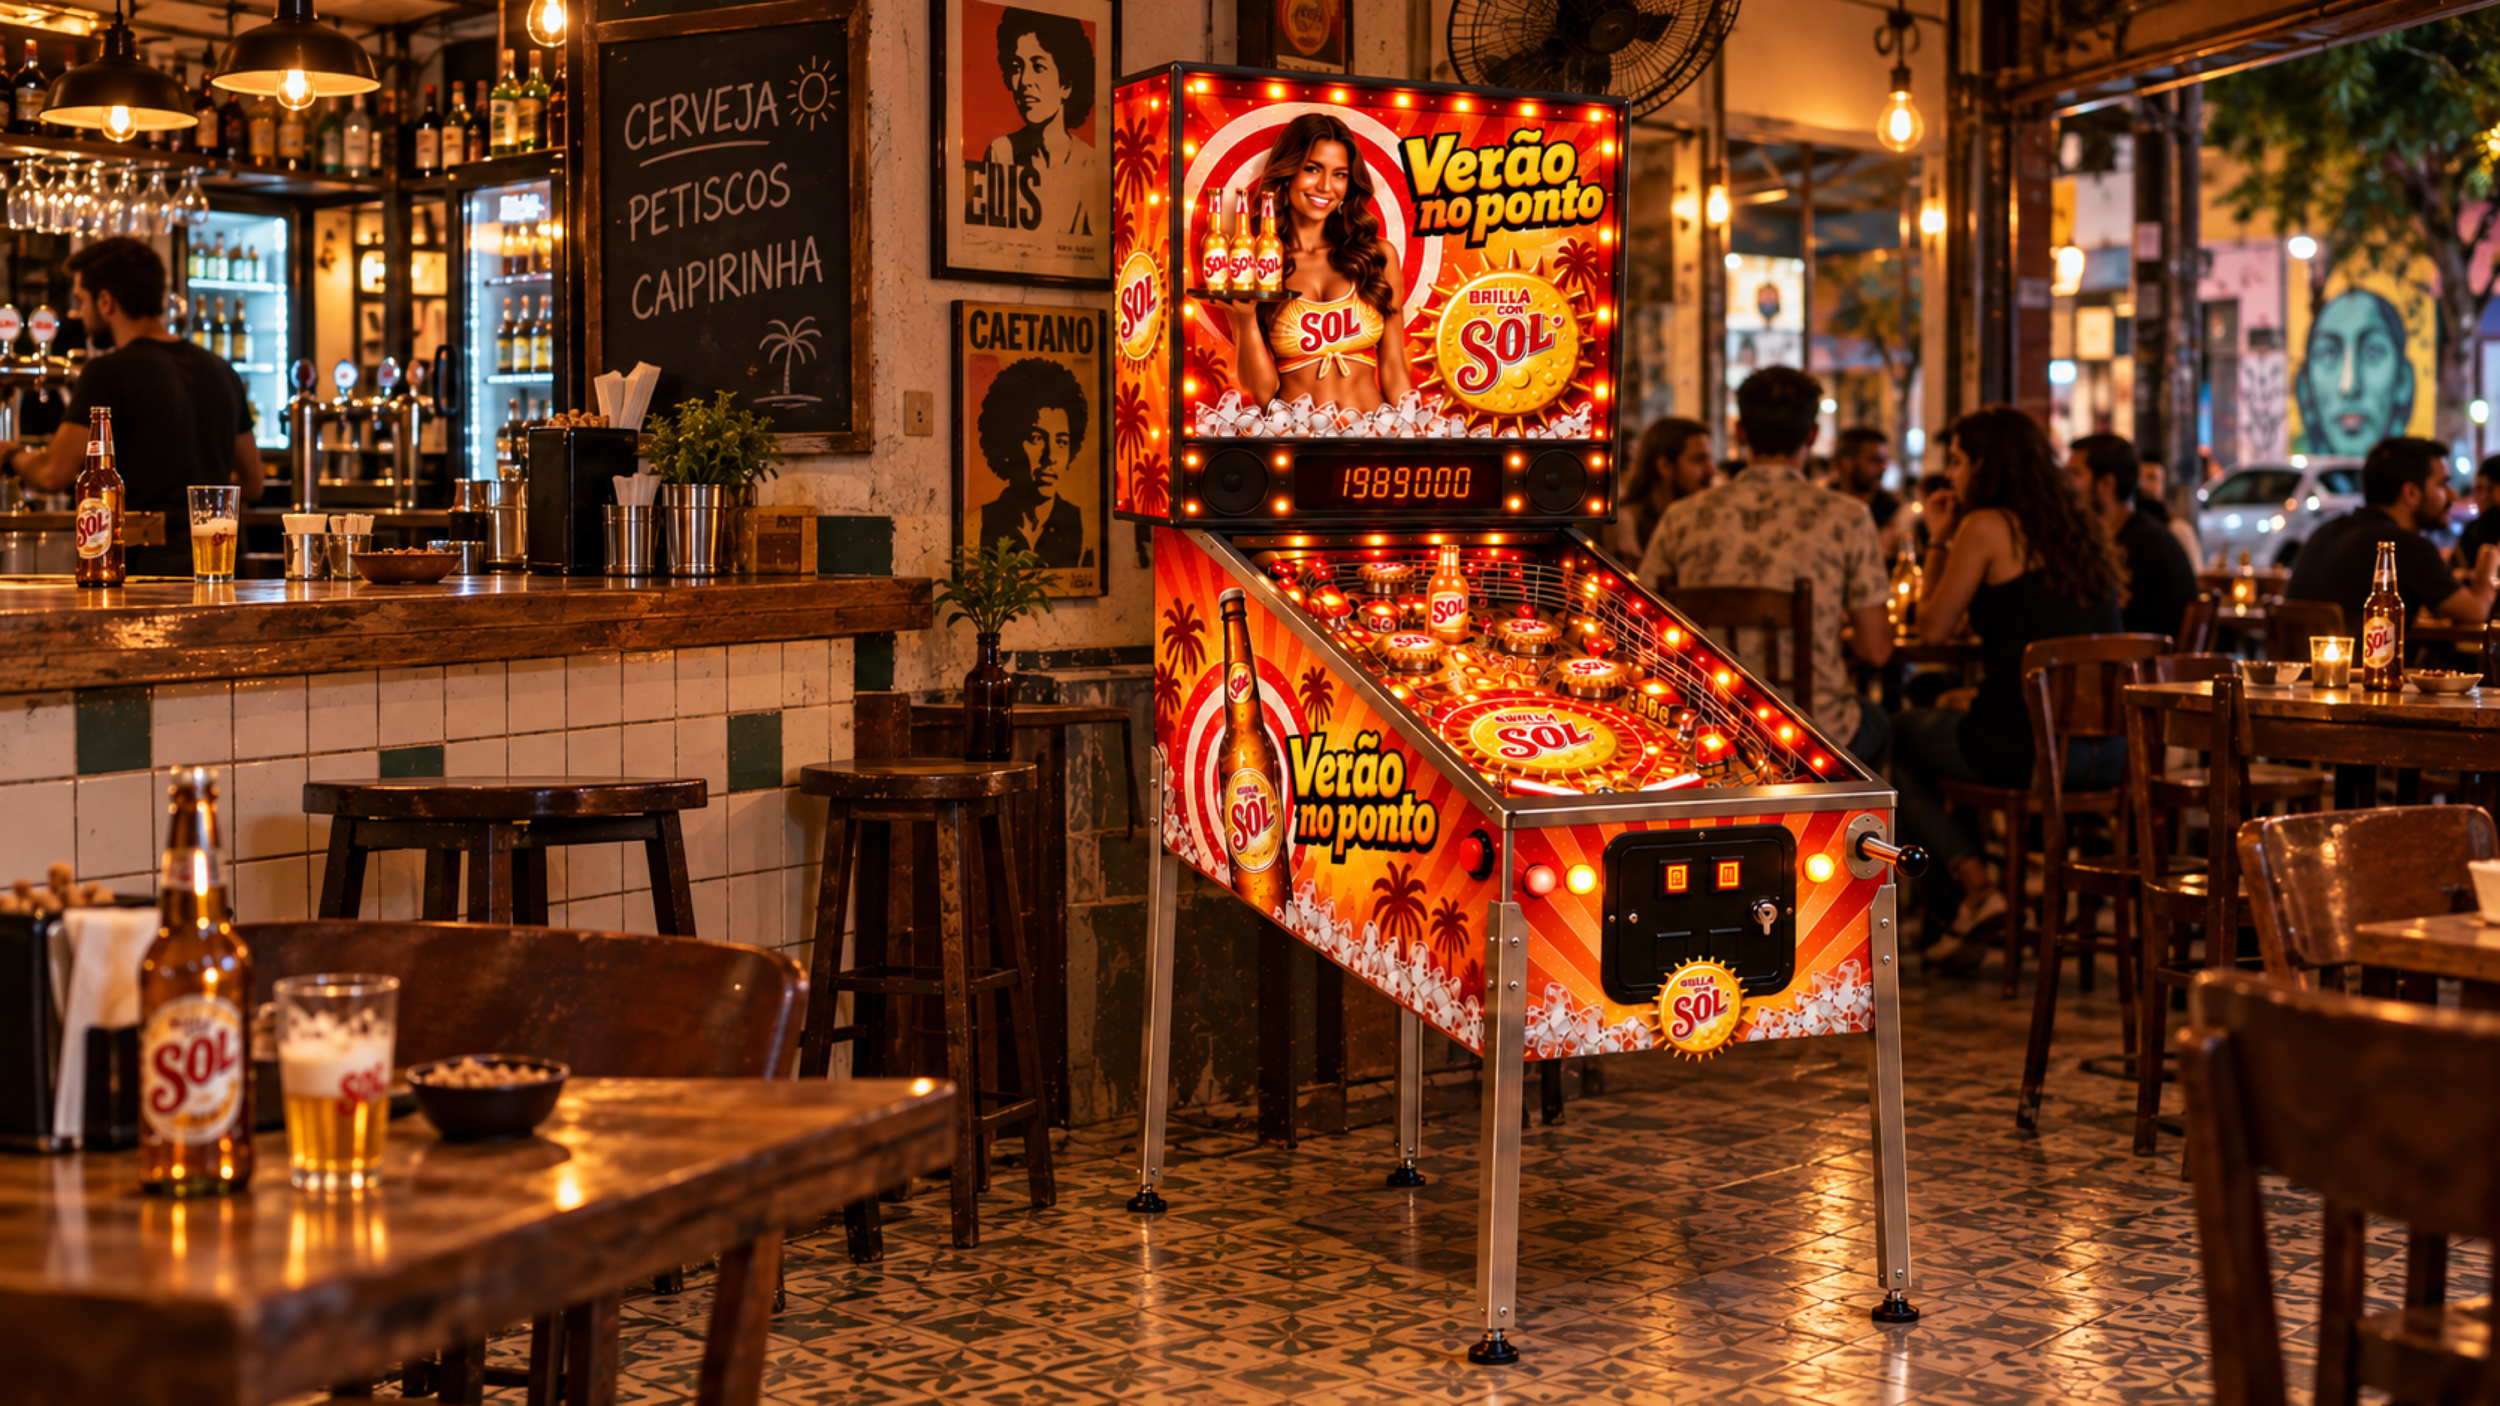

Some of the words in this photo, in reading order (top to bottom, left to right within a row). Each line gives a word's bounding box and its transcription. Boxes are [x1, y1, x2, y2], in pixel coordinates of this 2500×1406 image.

[624, 80, 780, 152] CERVEJA
[1401, 128, 1577, 198] Verão
[629, 162, 792, 243] PETISCOS
[1416, 195, 1473, 233] no
[1469, 177, 1606, 246] ponto
[630, 235, 824, 321] CAIPIRINHA
[1257, 256, 1281, 280] SOL
[1120, 273, 1158, 342] SOL
[1468, 288, 1532, 304] BRILLA
[1497, 304, 1524, 316] CON
[969, 309, 1094, 355] CAETANO
[1299, 307, 1361, 353] SOL
[1455, 312, 1557, 394] SOL
[1342, 466, 1471, 499] 1989000
[77, 511, 109, 548] SOL
[1430, 598, 1466, 625] SOL
[2364, 630, 2392, 658] SOL
[1287, 730, 1405, 799] Verão
[1496, 720, 1595, 760] SOL
[1231, 795, 1275, 854] SOL
[1296, 803, 1335, 842] no
[1332, 791, 1438, 860] ponto
[1671, 987, 1729, 1041] SOL
[151, 1028, 236, 1116] SOL
[337, 1063, 388, 1117] SOL
